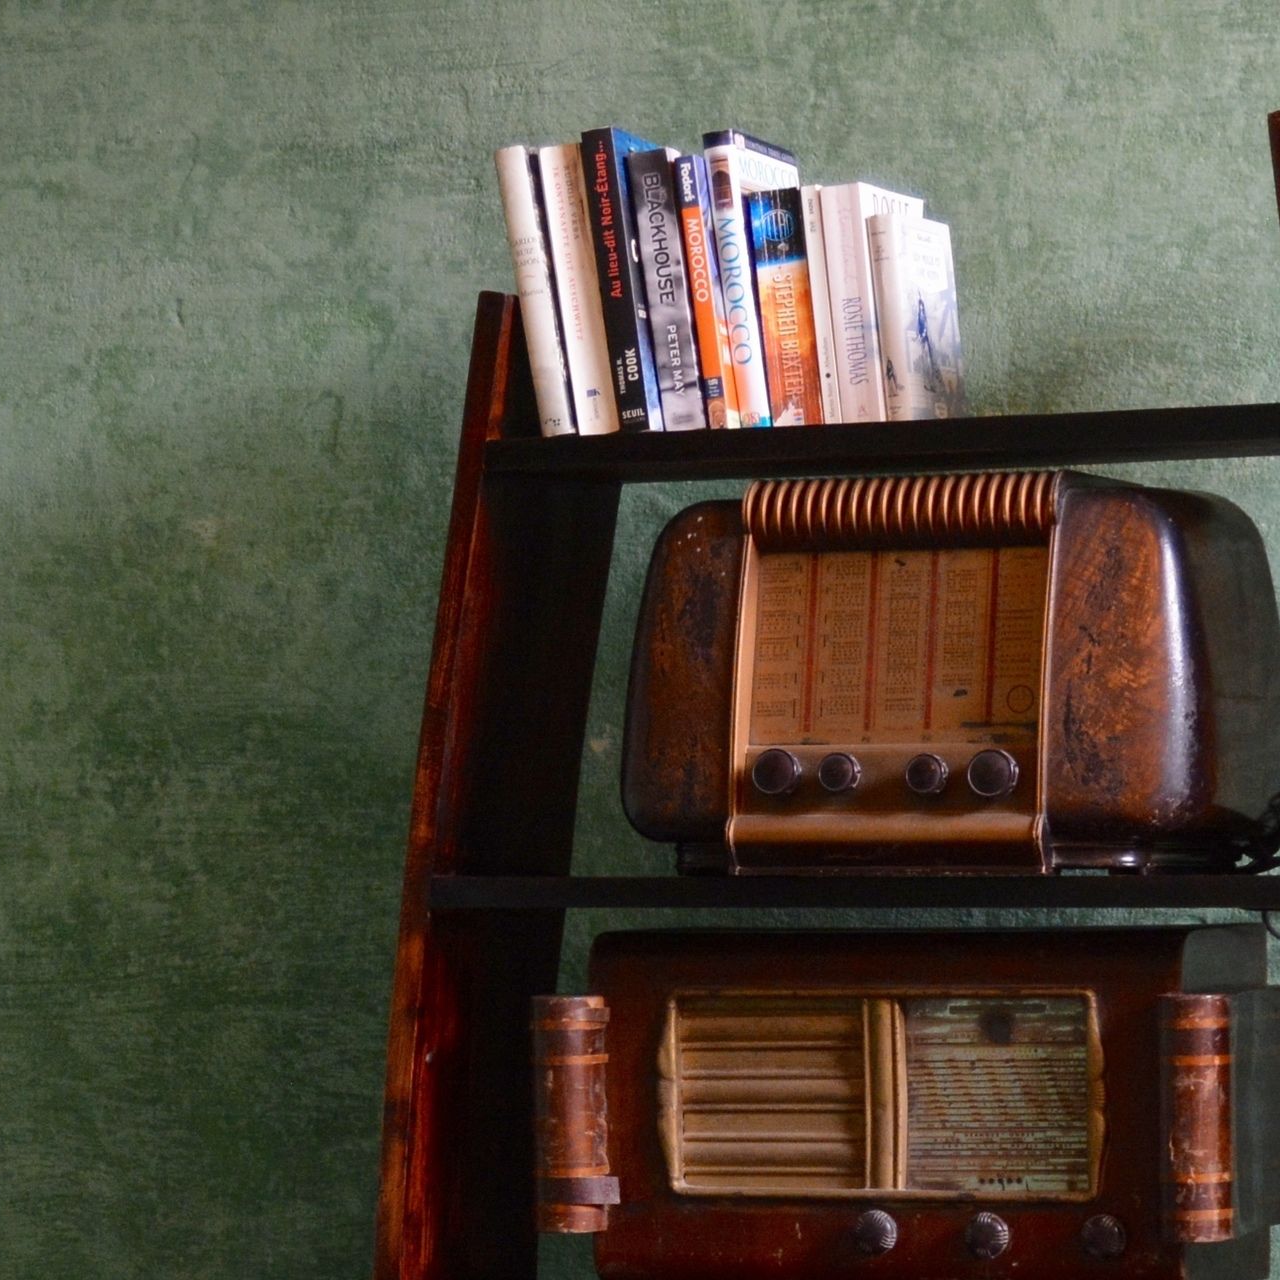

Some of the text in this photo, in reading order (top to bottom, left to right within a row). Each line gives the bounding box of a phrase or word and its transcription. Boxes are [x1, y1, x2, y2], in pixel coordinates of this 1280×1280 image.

[680, 162, 695, 202] Fodor's
[603, 229, 619, 277] lieu-dit
[643, 173, 675, 304] BLACKHOUSE
[687, 219, 709, 302] MOROCCO
[569, 276, 583, 340] AUSCHWITZ
[610, 279, 623, 298] Au
[718, 217, 752, 365] MOROCCO
[773, 273, 805, 399] STEPHEN BAXTER
[842, 297, 864, 331] ROSIE
[625, 347, 639, 381] COOK
[667, 324, 681, 367] PETER
[846, 334, 869, 385] THOMAS
[672, 370, 686, 396] MAY
[622, 407, 645, 420] SEUIL
